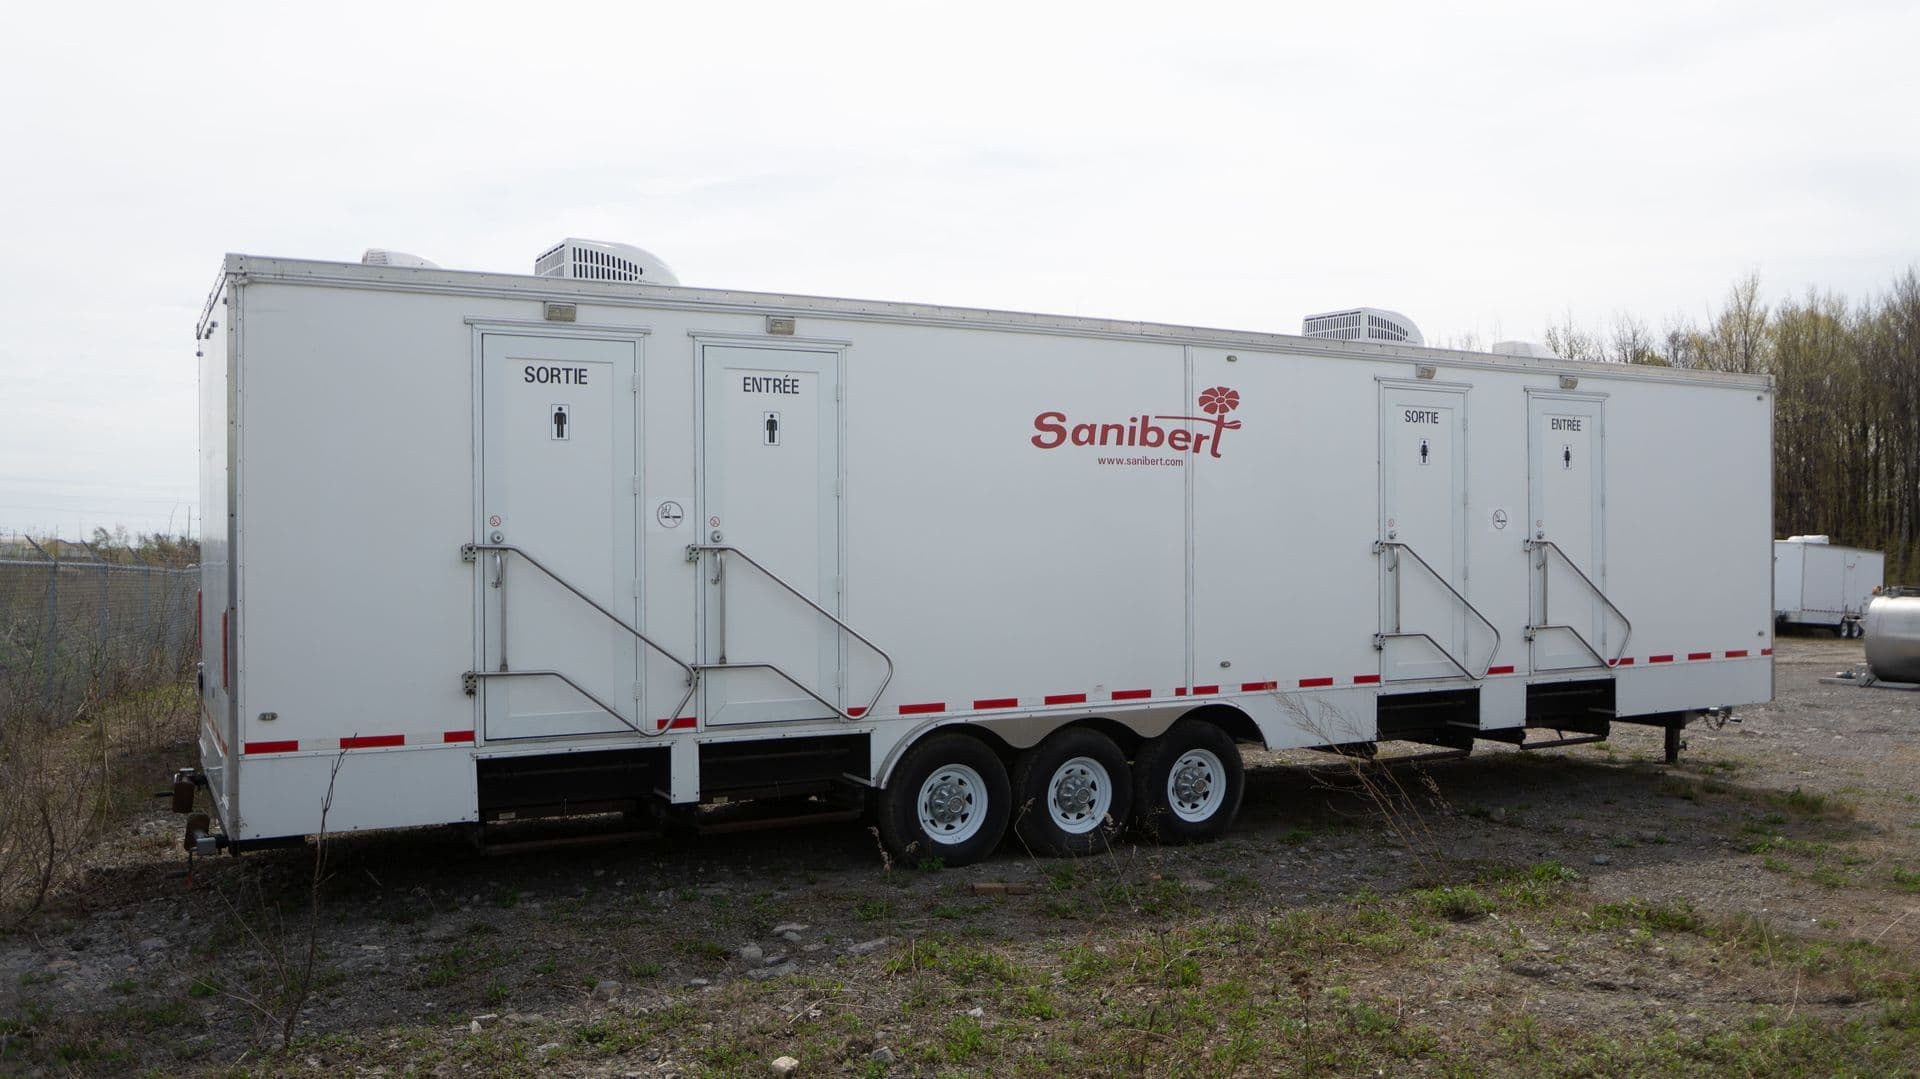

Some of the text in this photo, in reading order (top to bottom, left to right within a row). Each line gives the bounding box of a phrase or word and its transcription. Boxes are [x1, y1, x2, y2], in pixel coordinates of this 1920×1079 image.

[524, 366, 588, 385] SORTIE
[743, 374, 800, 394] ENTRÉE
[1405, 410, 1439, 424] SORTIE
[1551, 416, 1581, 431] ENTRÉE
[1031, 411, 1241, 458] Sanibert
[1097, 455, 1184, 467] www.sanibert.com
